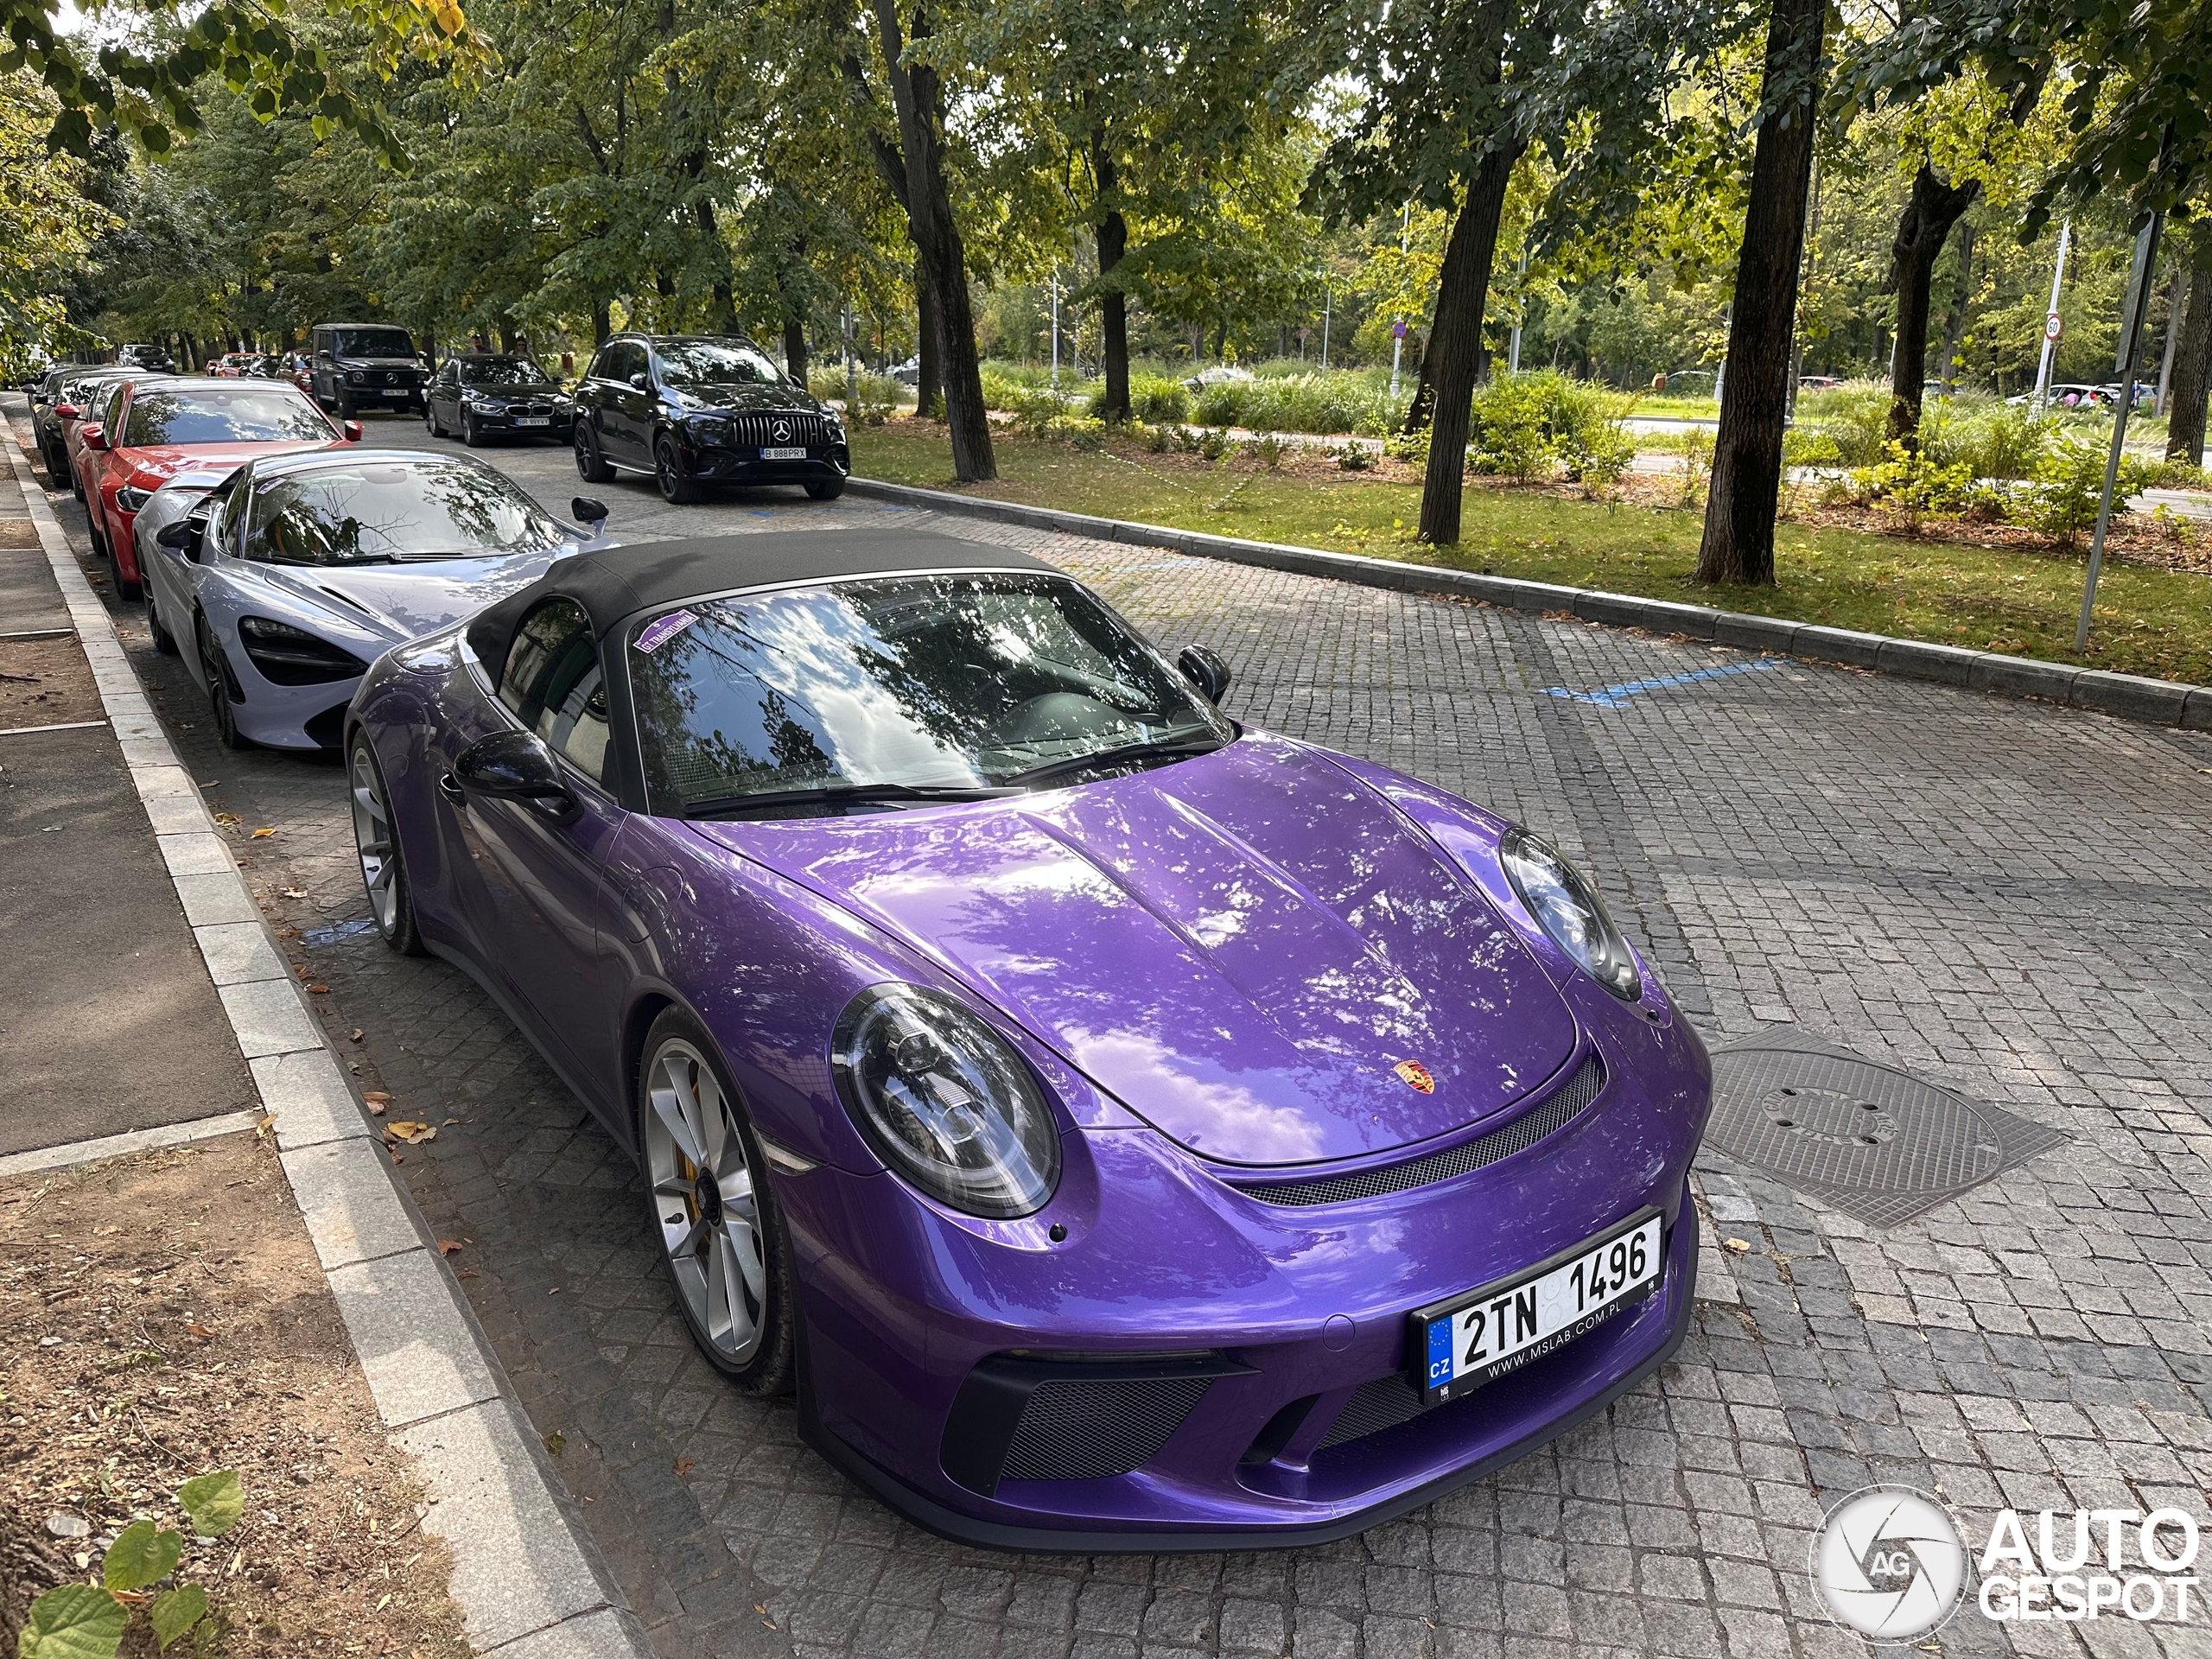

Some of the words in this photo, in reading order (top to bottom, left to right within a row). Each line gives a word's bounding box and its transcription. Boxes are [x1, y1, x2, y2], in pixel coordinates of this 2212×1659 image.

[2049, 321, 2058, 333] 60
[766, 449, 772, 458] B
[641, 640, 655, 651] GT
[650, 614, 695, 645] TRANSYLVANIA
[1463, 1284, 1539, 1366] 2TN
[1569, 1230, 1647, 1313] 1496
[1487, 1304, 1621, 1378] WWW.MSLAB.COM.PL
[1430, 1357, 1450, 1379] CZ
